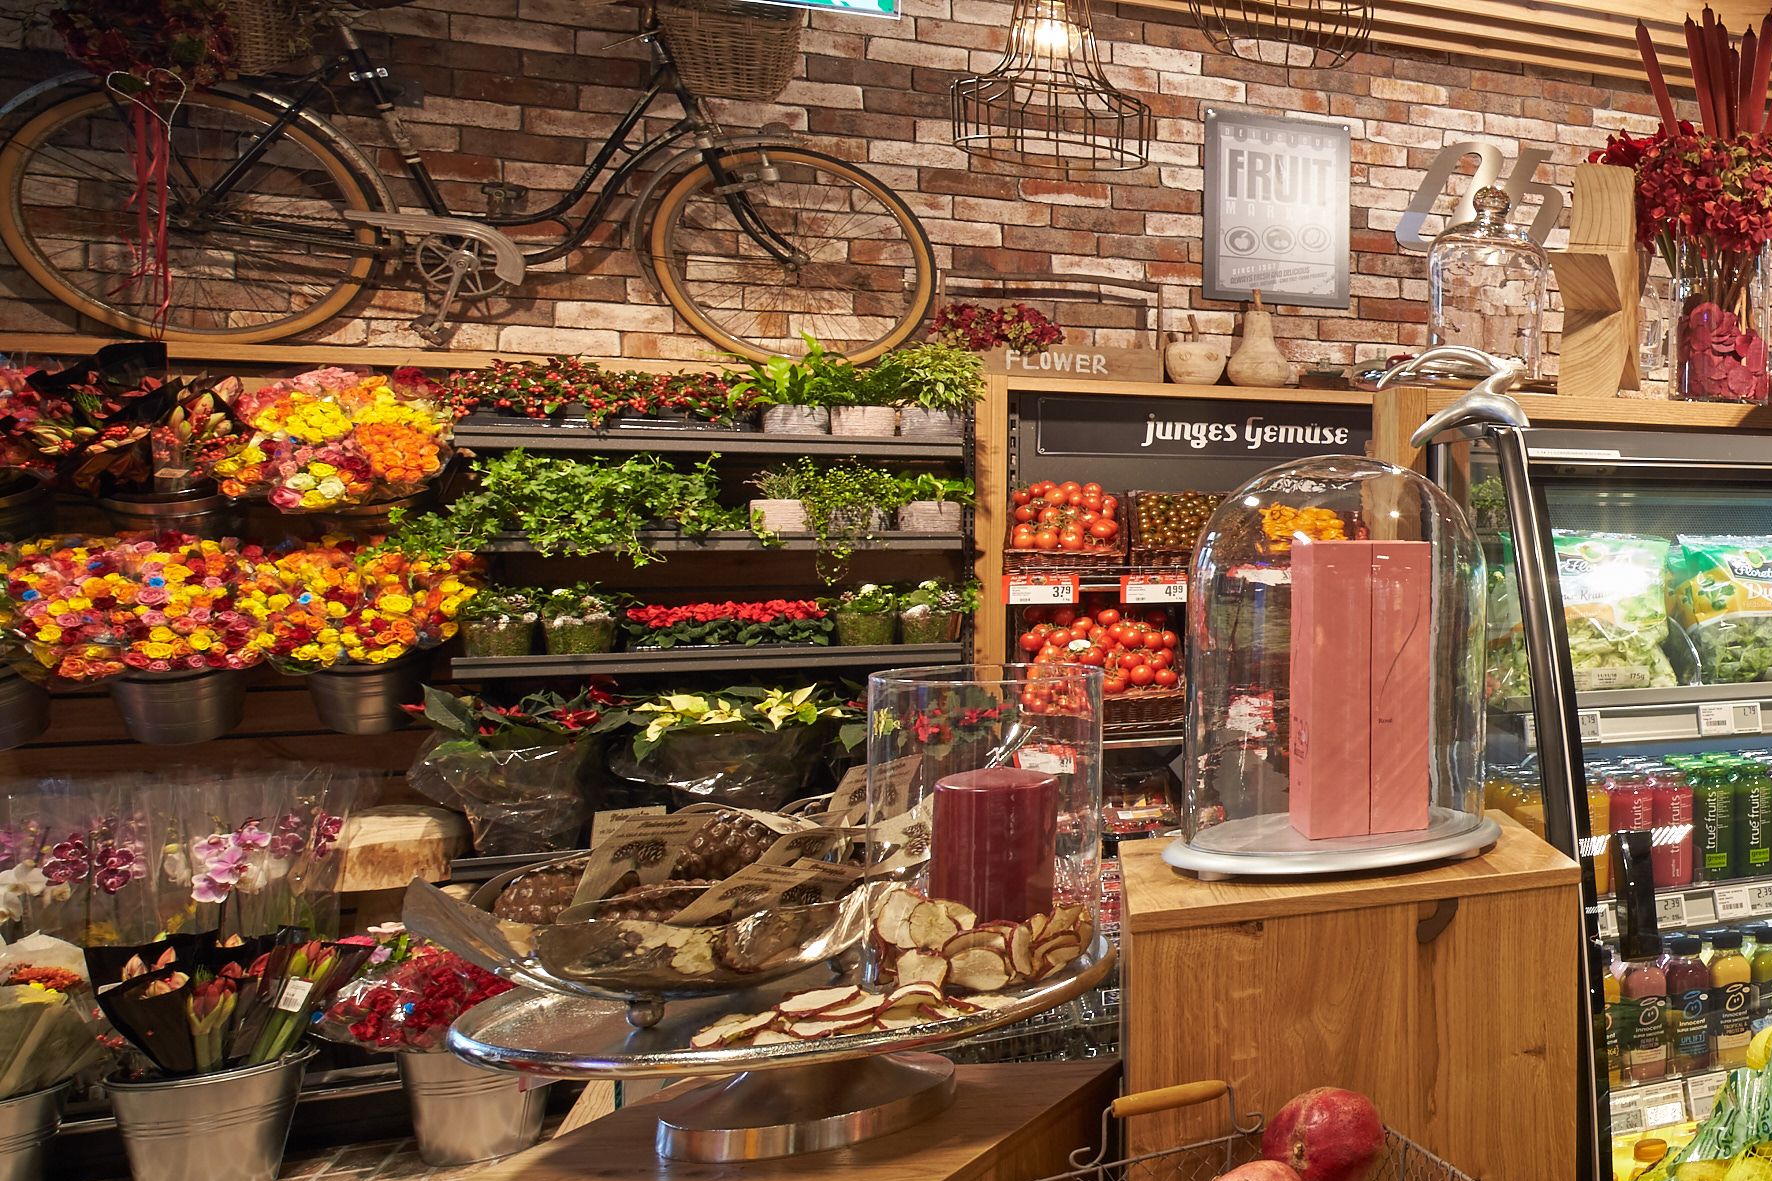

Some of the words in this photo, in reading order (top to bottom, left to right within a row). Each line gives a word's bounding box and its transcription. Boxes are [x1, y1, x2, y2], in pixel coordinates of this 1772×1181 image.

[1224, 127, 1334, 148] DELICIOUS
[1225, 148, 1333, 206] FRUIT
[1005, 350, 1109, 374] FLOWER
[1141, 413, 1238, 447] junges
[1244, 417, 1349, 450] Gemüse
[1052, 586, 1071, 598] 3.79
[1165, 586, 1183, 597] 4.99
[1630, 672, 1645, 681] 175g
[1631, 798, 1642, 829] fruits
[1671, 795, 1681, 825] fruits
[1707, 791, 1717, 824] fruits
[1748, 787, 1759, 820] fruits
[1707, 825, 1716, 849] true
[1749, 820, 1759, 845] true
[1707, 853, 1726, 862] green
[1751, 849, 1769, 858] green
[1663, 898, 1680, 909] 2.39
[1757, 887, 1772, 898] 2.39
[1681, 1033, 1704, 1044] UPLIFT
